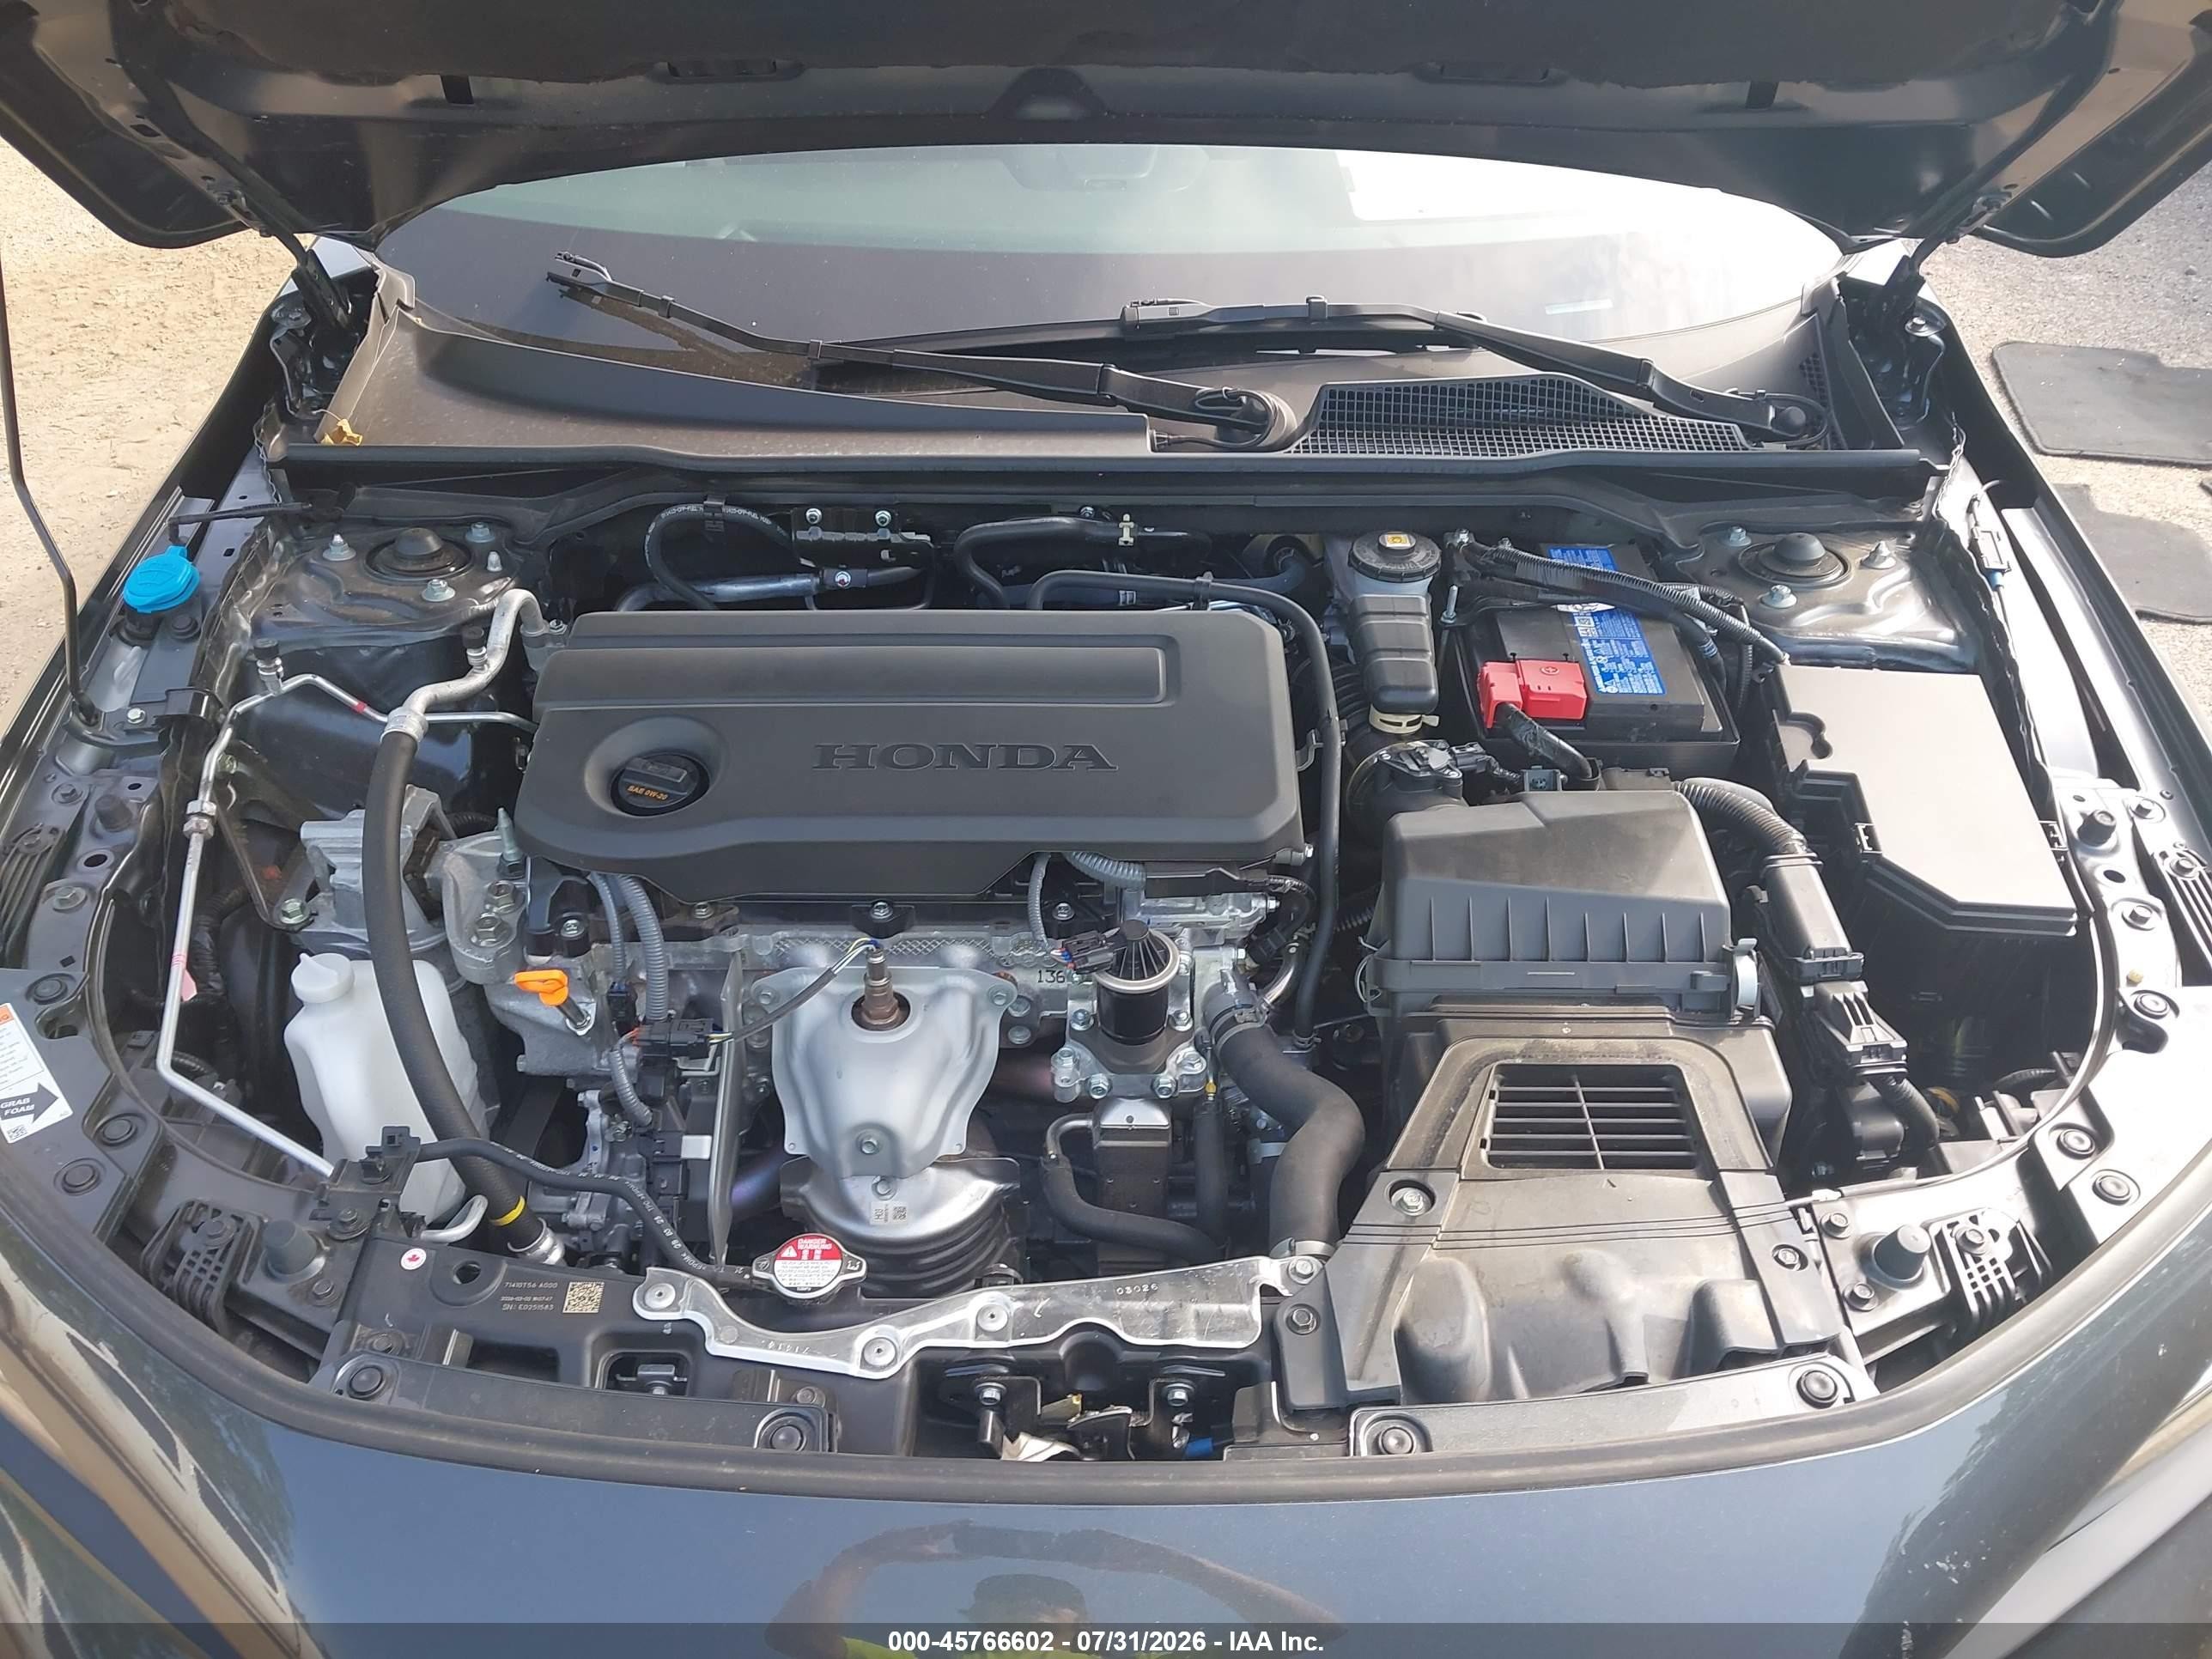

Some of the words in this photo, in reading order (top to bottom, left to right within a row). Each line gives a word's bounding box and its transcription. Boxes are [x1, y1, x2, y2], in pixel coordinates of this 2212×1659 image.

[811, 743, 1119, 771] HONDA
[627, 785, 645, 795] SAE
[644, 789, 668, 800] 0W-20
[1037, 969, 1066, 984] 136
[0, 1097, 31, 1109] GRAB
[4, 1104, 35, 1116] FOAM
